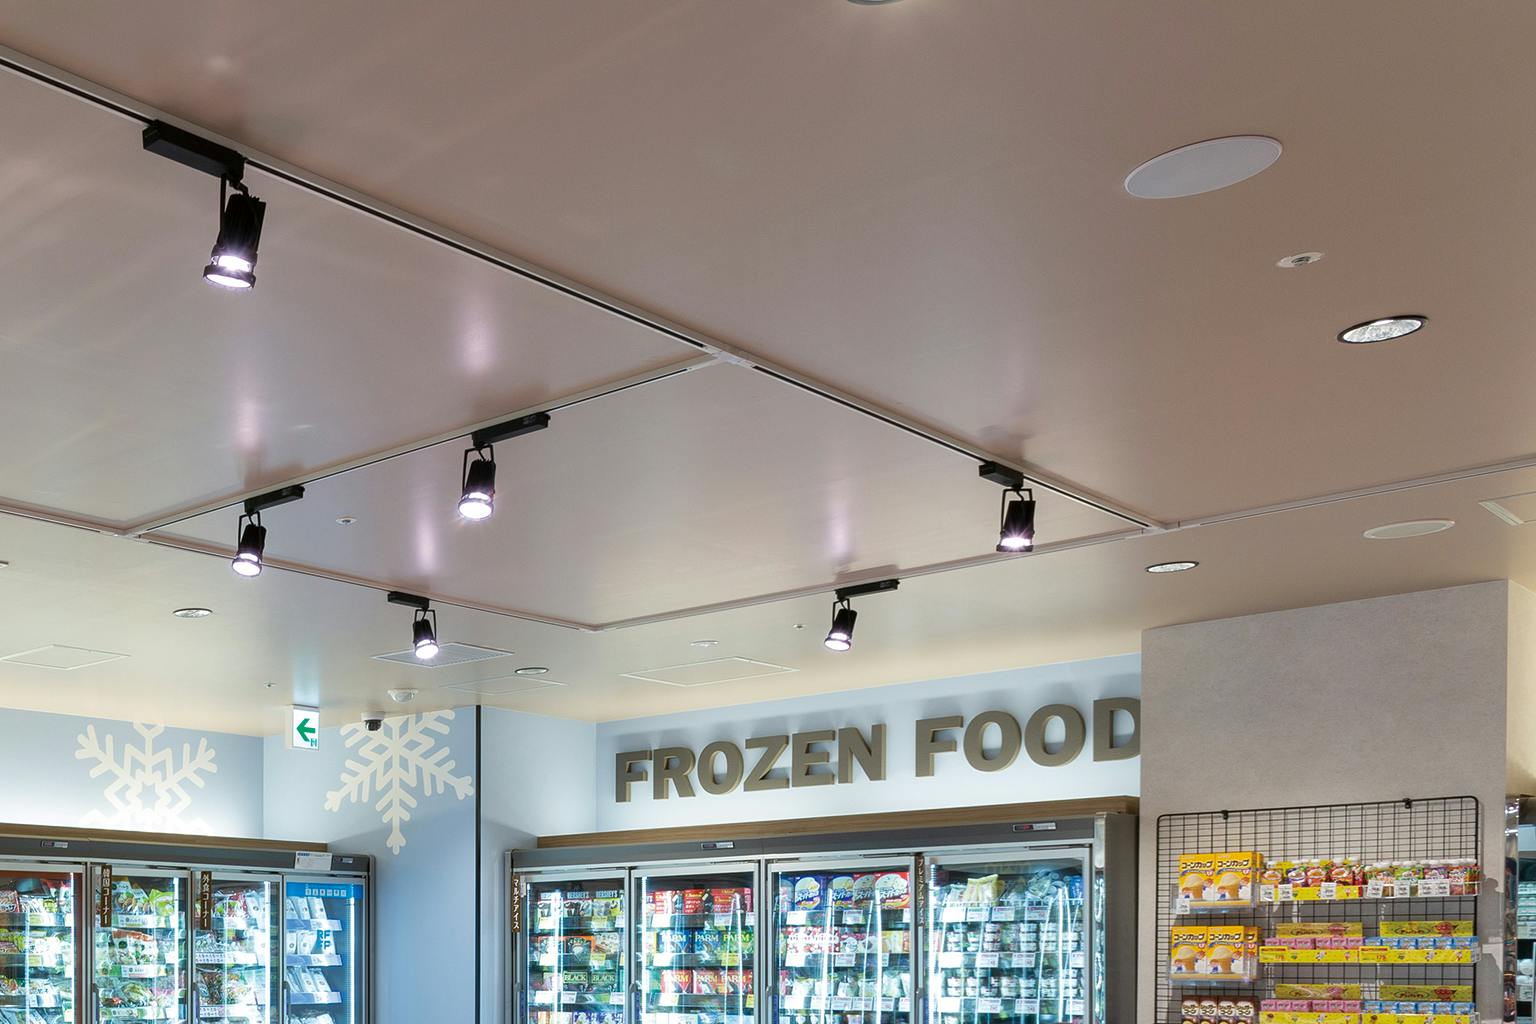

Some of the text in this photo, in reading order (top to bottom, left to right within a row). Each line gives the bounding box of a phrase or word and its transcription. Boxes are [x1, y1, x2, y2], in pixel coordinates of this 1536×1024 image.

[615, 697, 1141, 803] FROZEN FOOD
[1181, 861, 1213, 869] コーンカップ
[1217, 859, 1250, 868] コーンカップ
[101, 866, 111, 926] 韓国コーナー
[202, 873, 211, 929] 外食コーナー
[694, 933, 719, 942] PARM
[1209, 932, 1241, 941] コーンカップ
